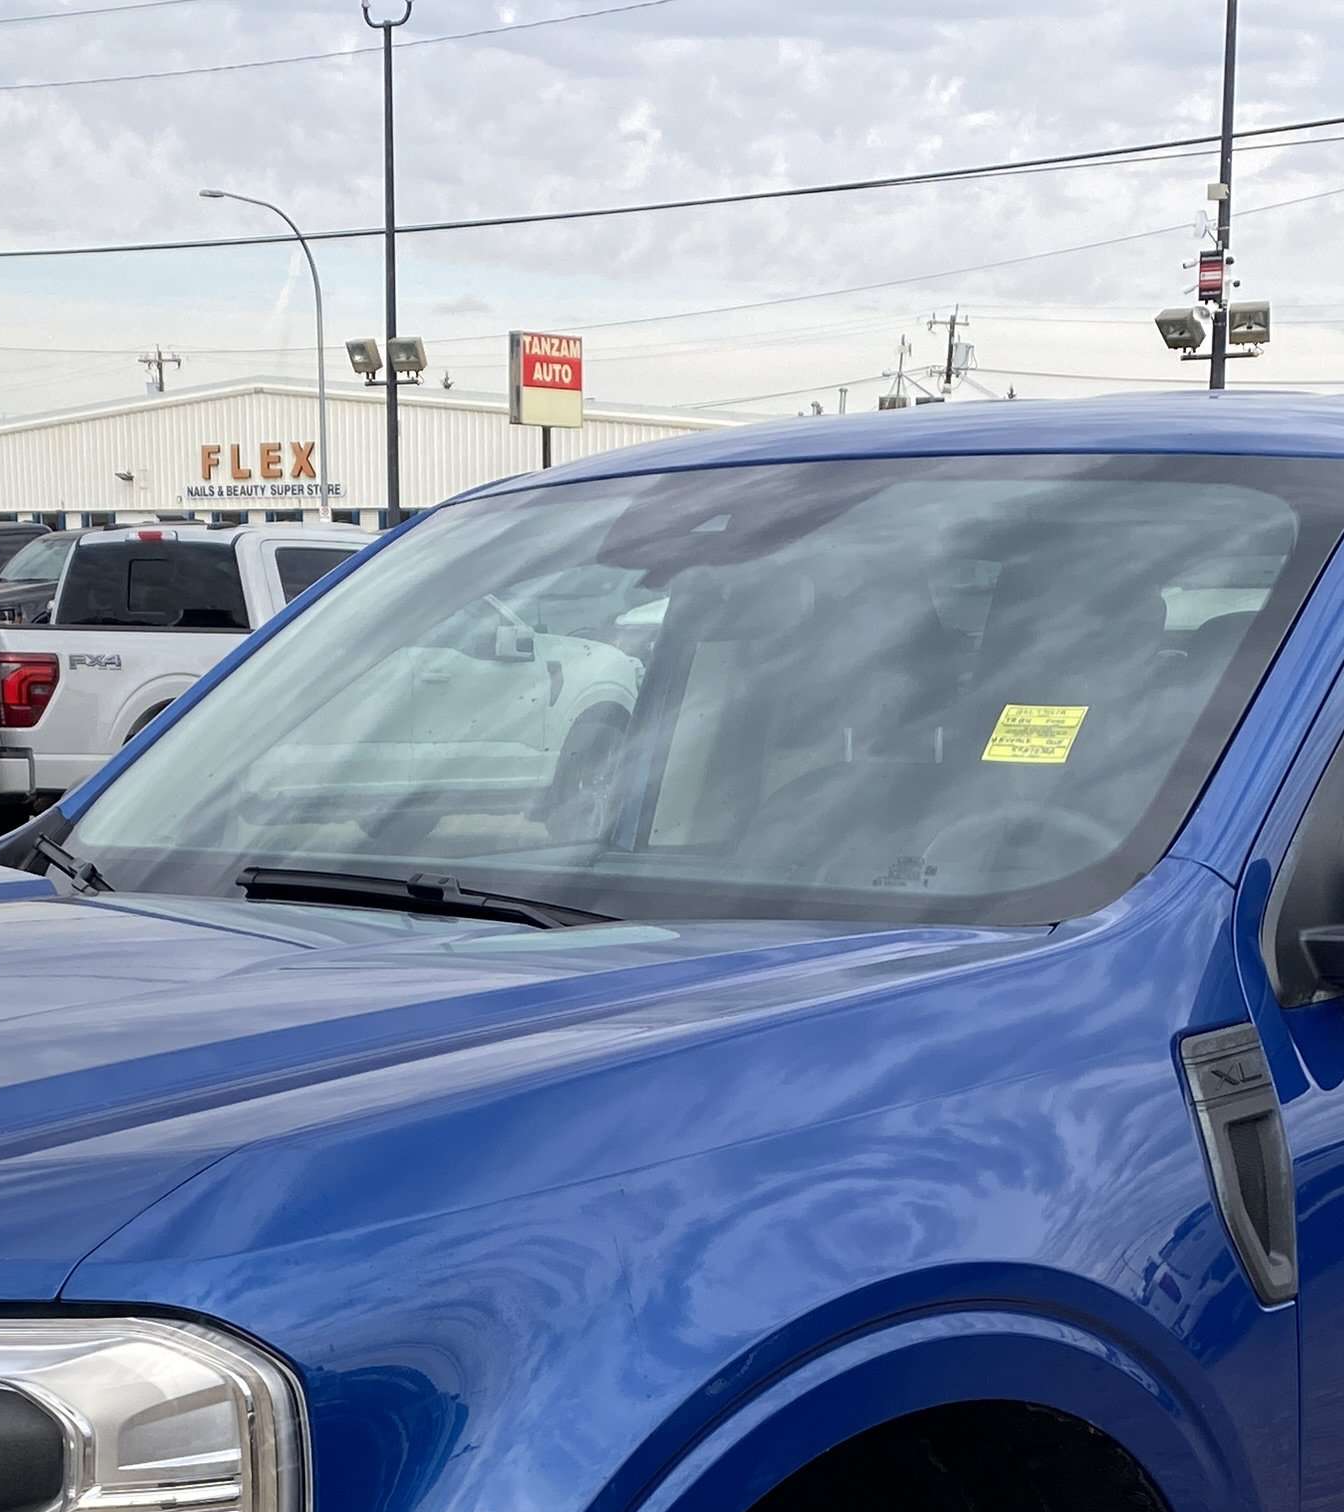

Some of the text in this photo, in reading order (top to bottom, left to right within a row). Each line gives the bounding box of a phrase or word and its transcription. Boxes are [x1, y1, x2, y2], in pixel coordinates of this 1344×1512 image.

[522, 335, 581, 359] TANZAM
[533, 361, 573, 384] AUTO
[201, 441, 317, 480] FLEX
[187, 483, 342, 497] NAILS & BEAUTY SUPER STRE
[69, 654, 122, 670] FX4
[1211, 1062, 1263, 1090] XL
